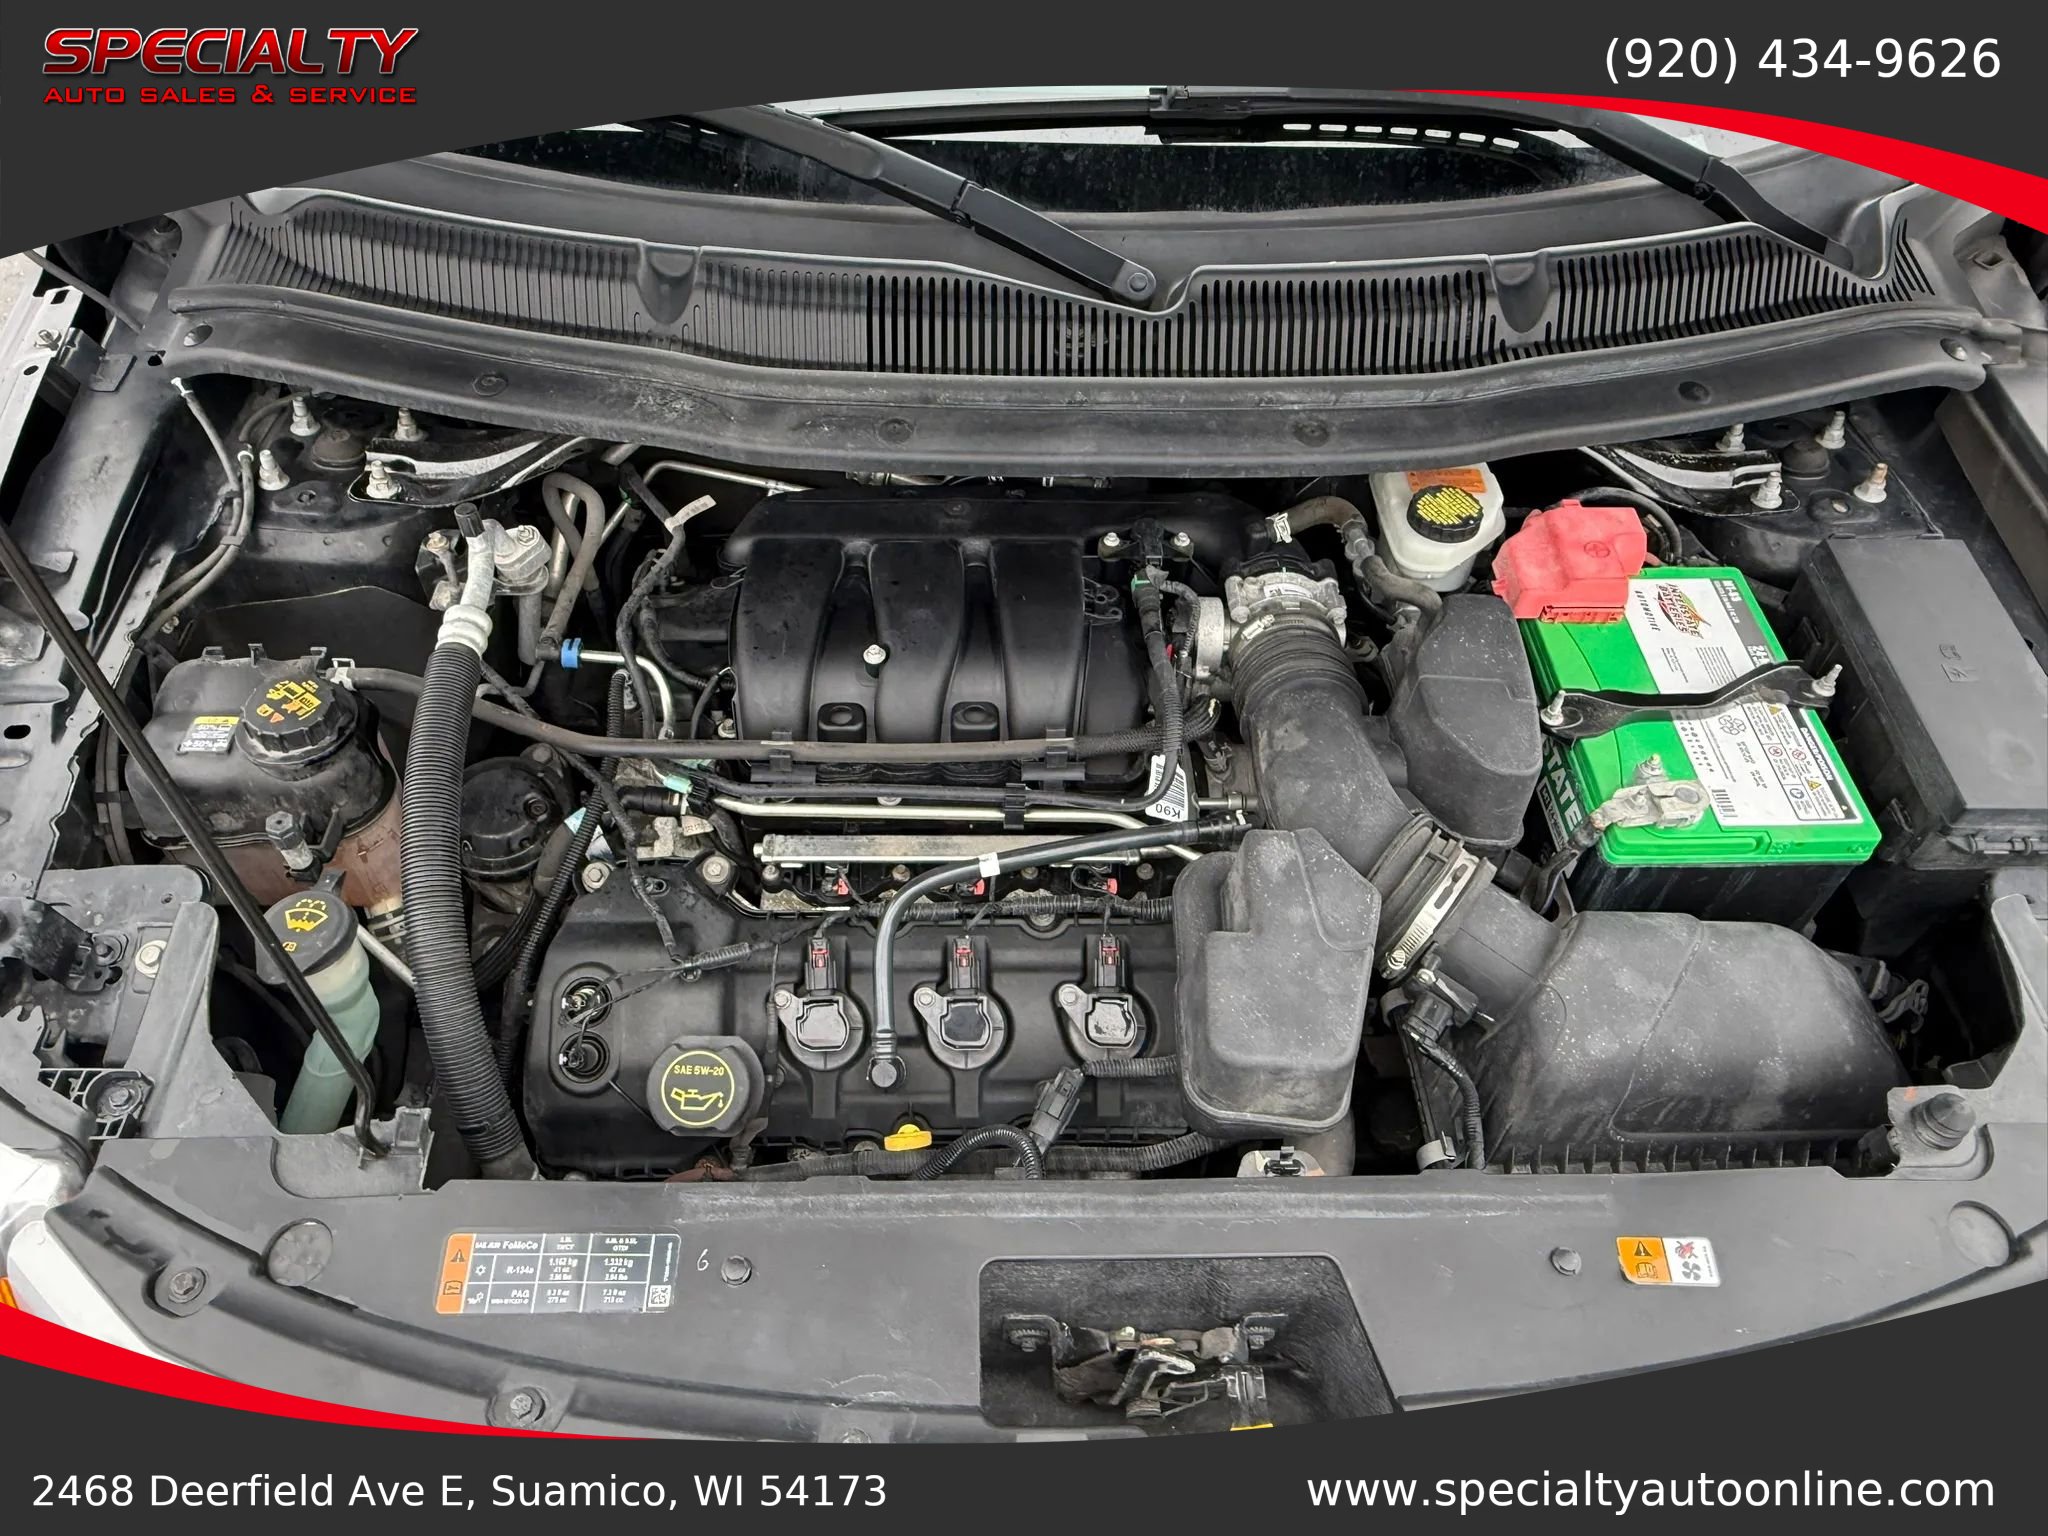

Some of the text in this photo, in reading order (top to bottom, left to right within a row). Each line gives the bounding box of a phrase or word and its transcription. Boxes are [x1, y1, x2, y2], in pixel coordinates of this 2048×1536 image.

[673, 1064, 725, 1076] SAE 5W-20
[502, 1240, 539, 1250] FoMoCo
[696, 1248, 710, 1271] 6
